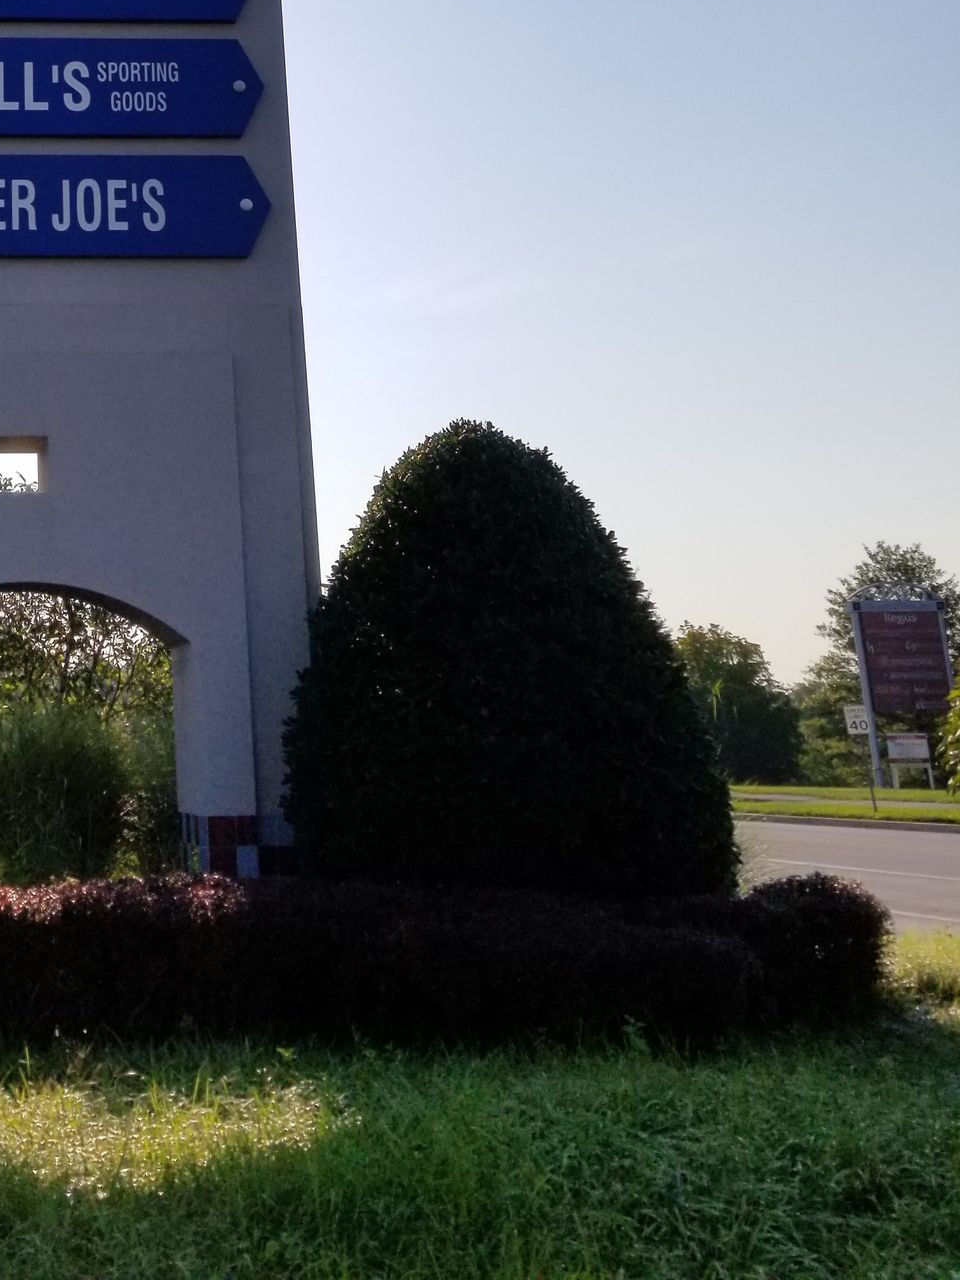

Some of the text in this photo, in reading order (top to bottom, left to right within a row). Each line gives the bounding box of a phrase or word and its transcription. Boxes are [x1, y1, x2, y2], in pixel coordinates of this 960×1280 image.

[97, 61, 179, 83] SPORTING
[110, 91, 167, 112] GOODS
[51, 178, 166, 232] JOE'S
[849, 720, 868, 731] 40
